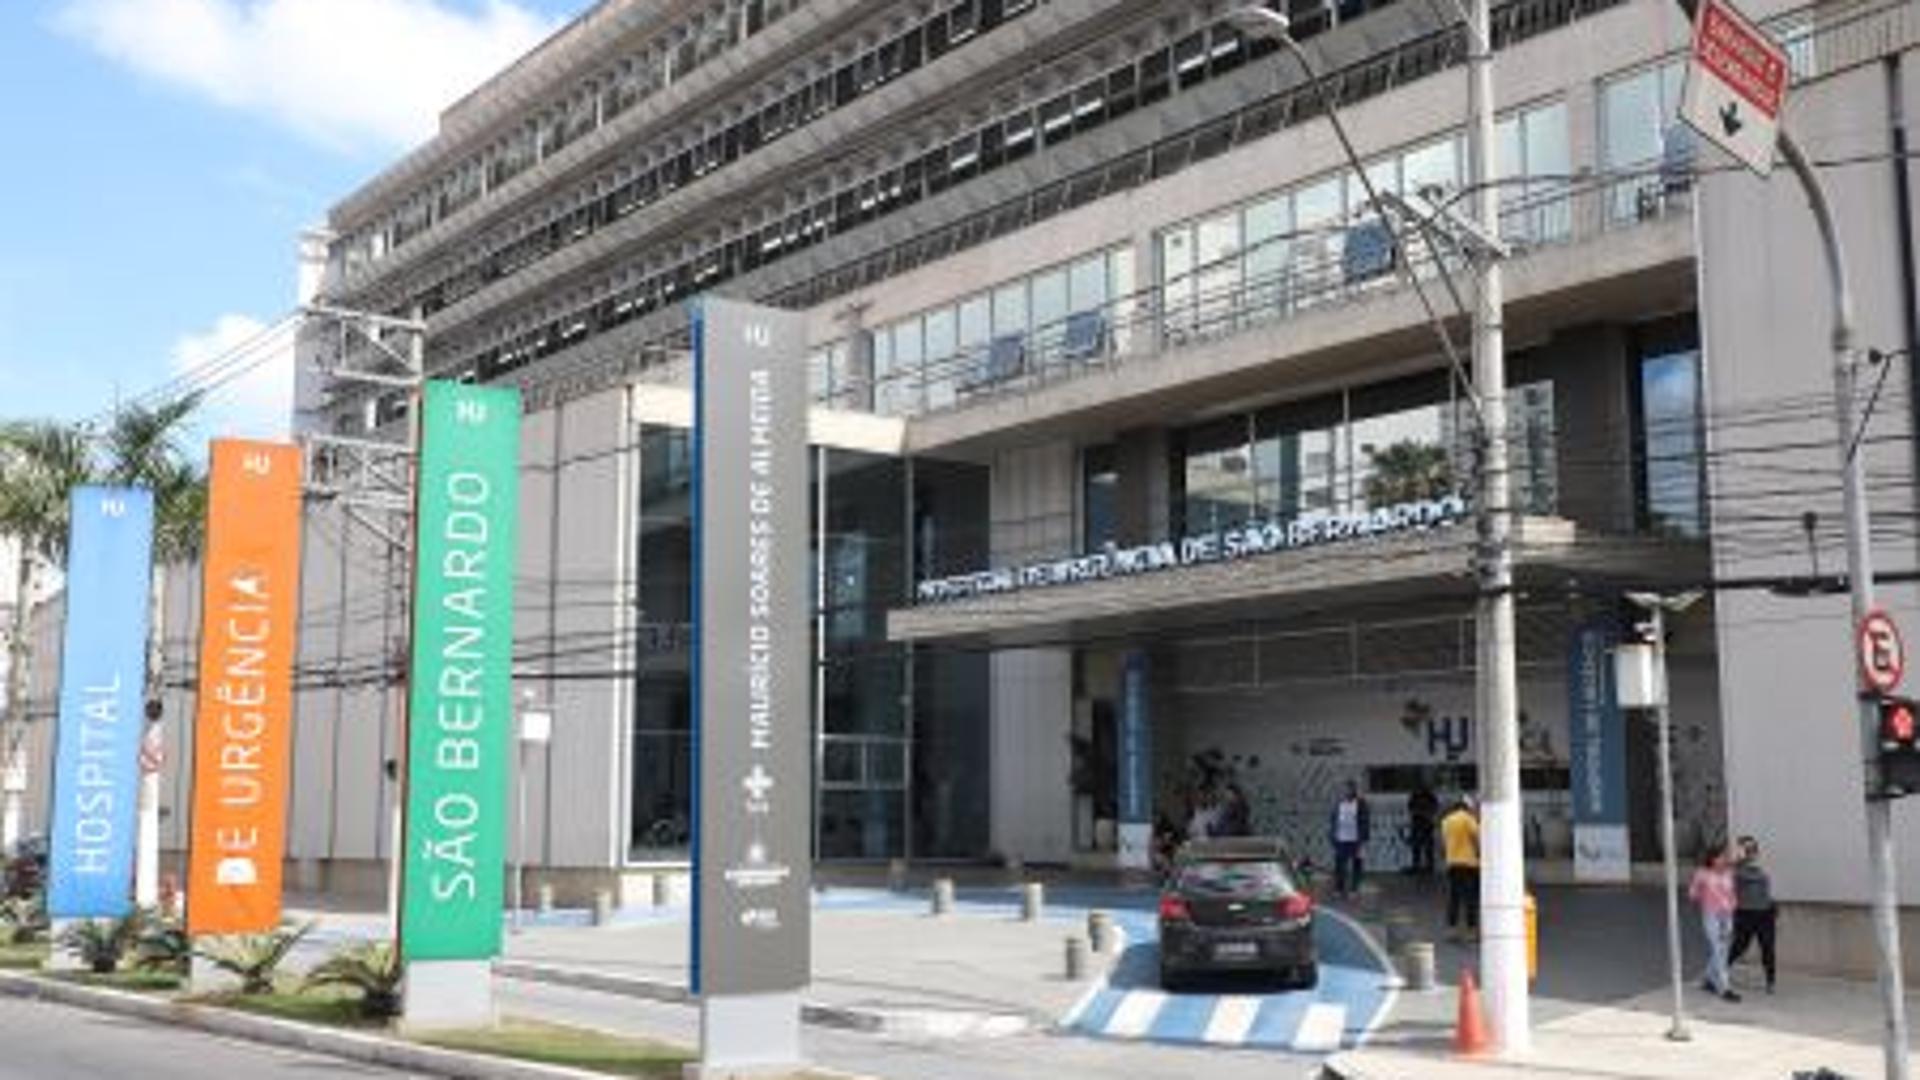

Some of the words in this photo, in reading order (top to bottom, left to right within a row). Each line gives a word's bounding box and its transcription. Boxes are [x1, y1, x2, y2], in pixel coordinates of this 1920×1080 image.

[750, 481, 773, 514] DE
[1180, 534, 1218, 564] DE
[750, 518, 773, 617] SOARES
[437, 472, 489, 770] BERNARDO
[216, 573, 271, 807] URGÊNCIA
[75, 670, 121, 874] HOSPITAL
[216, 826, 257, 886] DE
[424, 792, 479, 901] SÃO
